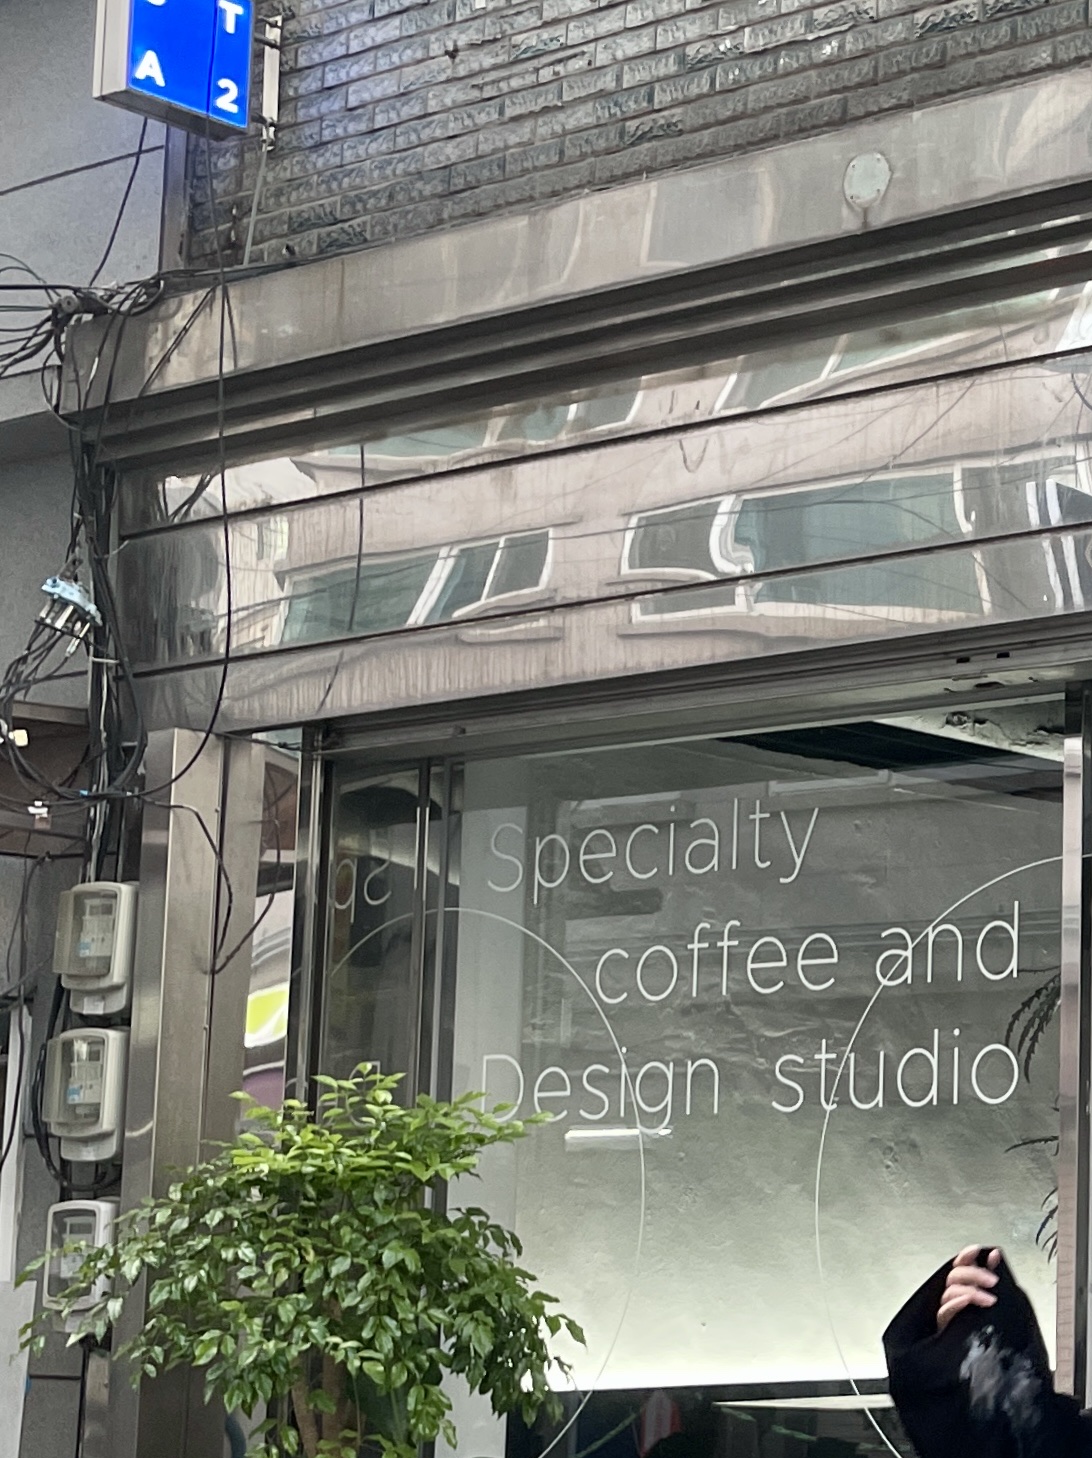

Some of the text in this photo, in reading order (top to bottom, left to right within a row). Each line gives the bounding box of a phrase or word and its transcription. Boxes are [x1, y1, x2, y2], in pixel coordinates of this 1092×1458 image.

[218, 0, 244, 34] T
[134, 50, 239, 114] A 2
[487, 798, 819, 905] Specialty
[595, 900, 1020, 1004] coffee and
[481, 1028, 1019, 1135] Design studio
